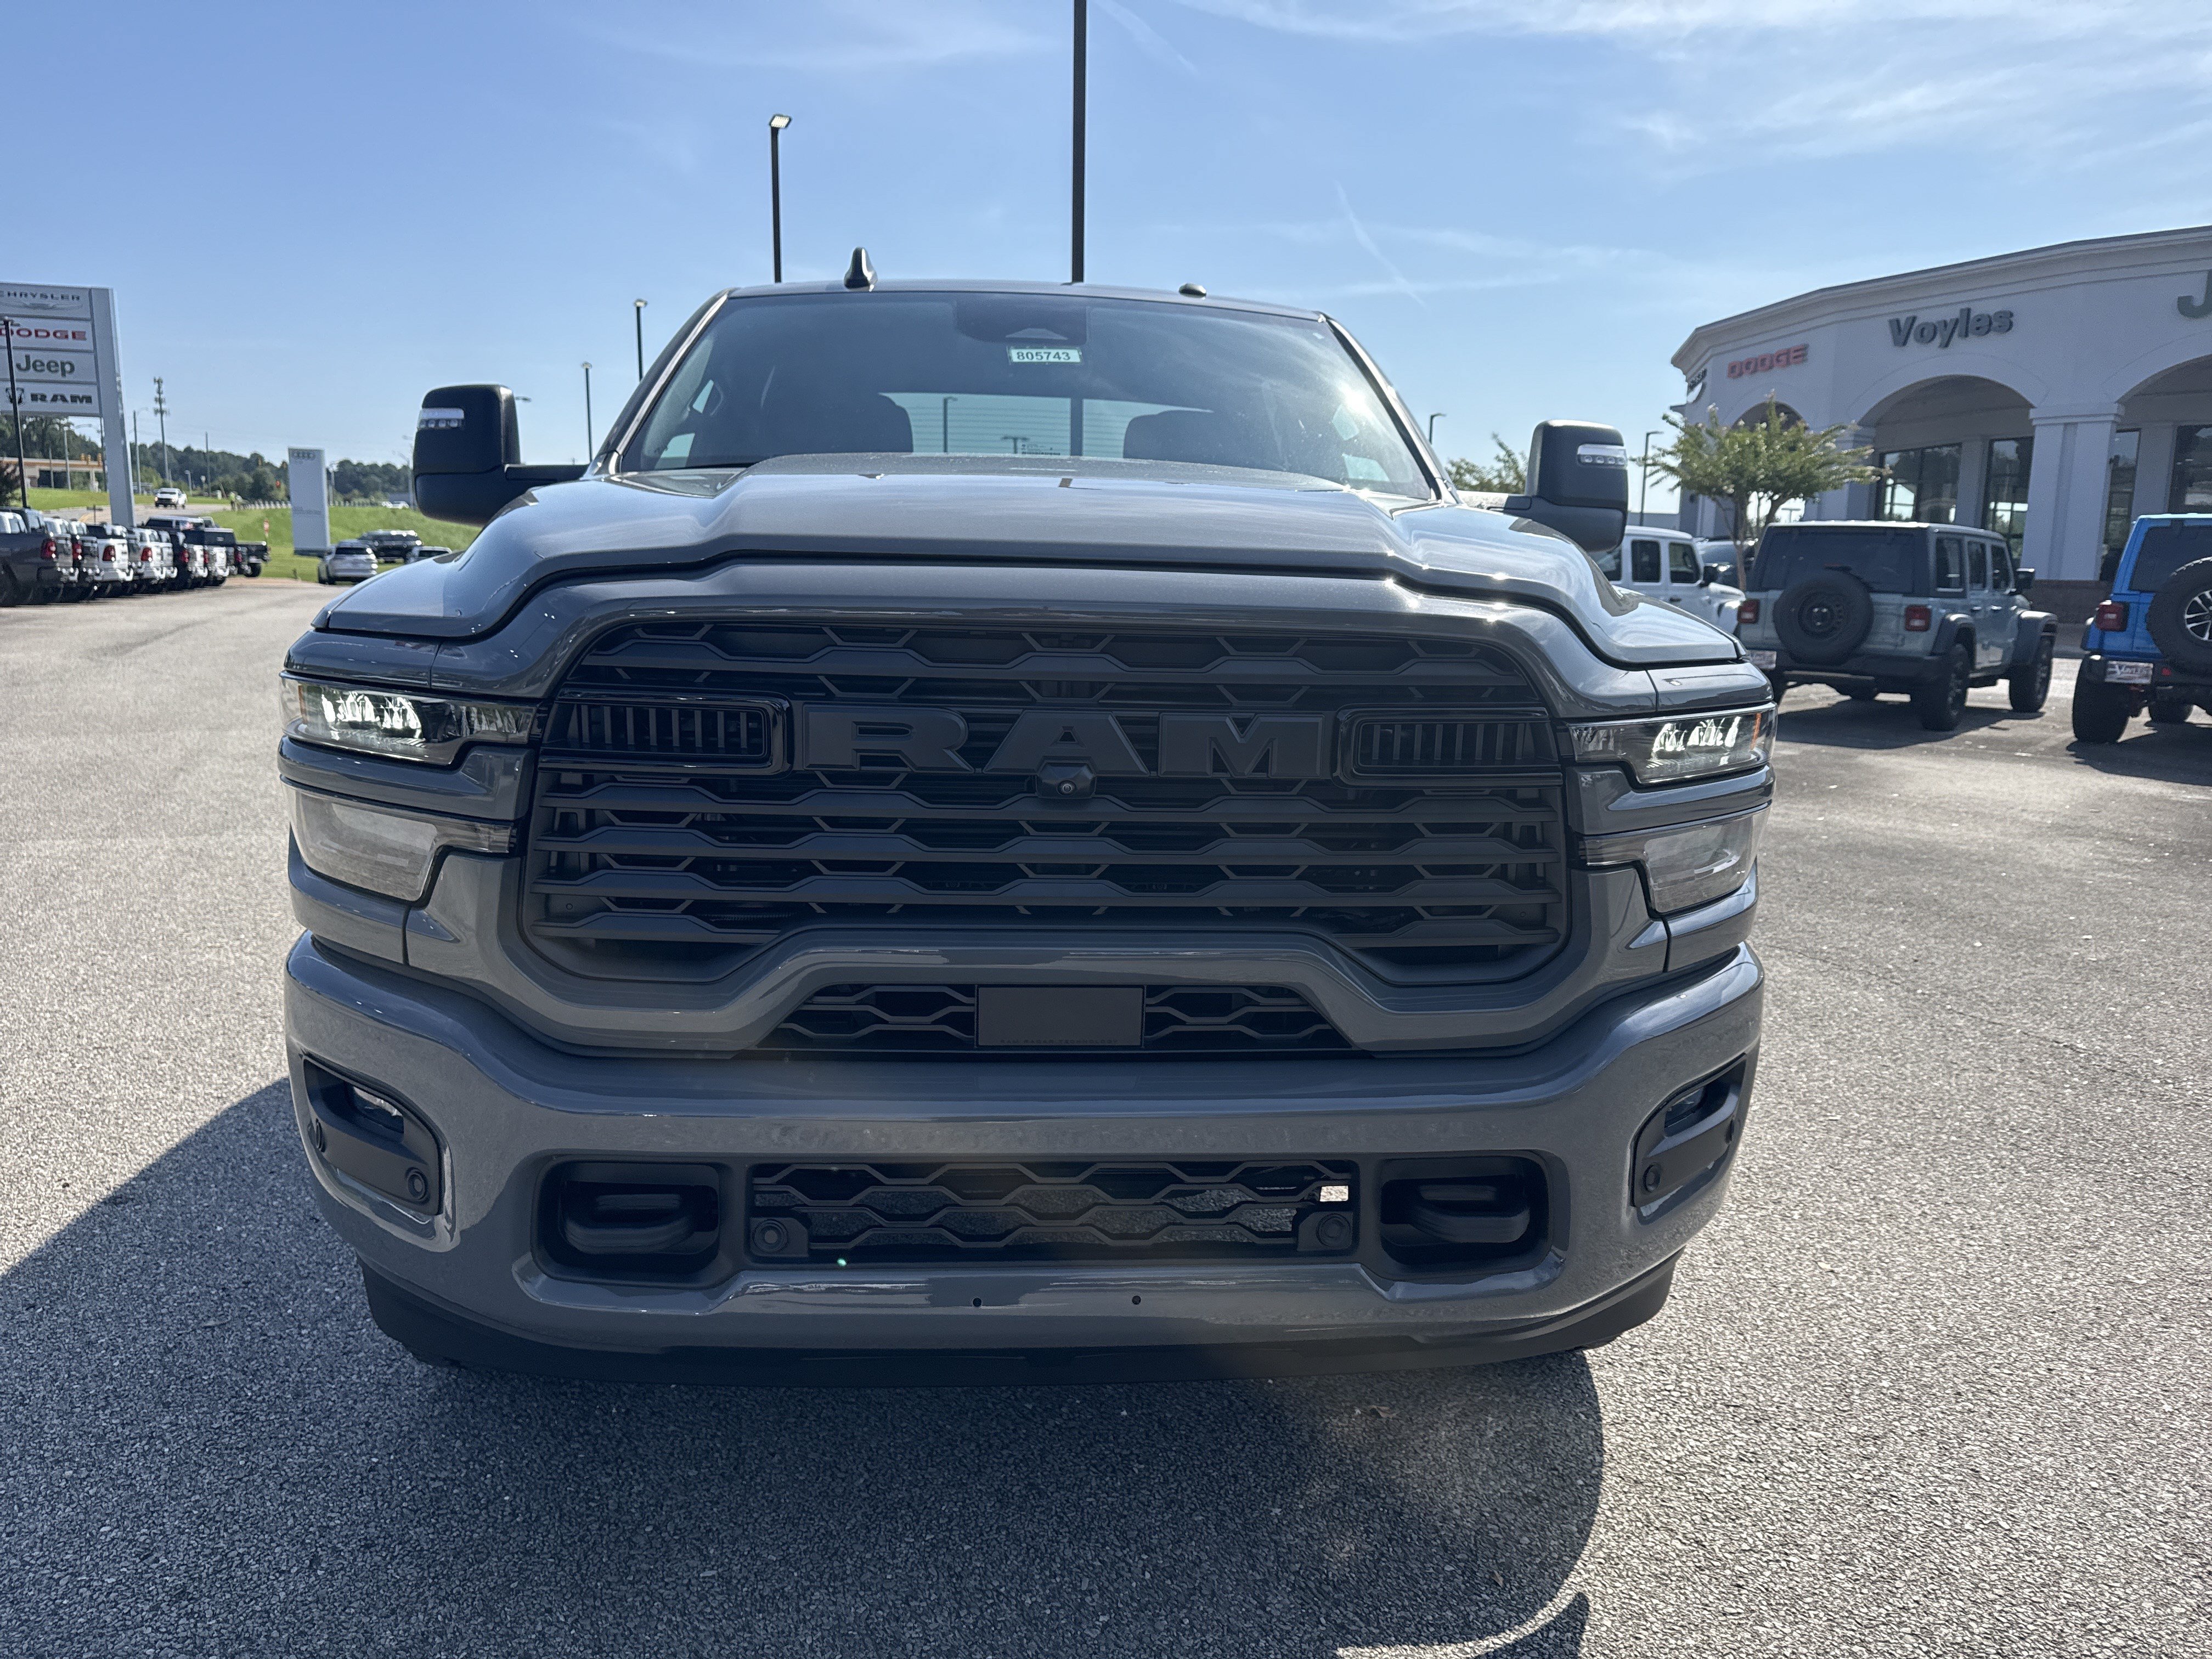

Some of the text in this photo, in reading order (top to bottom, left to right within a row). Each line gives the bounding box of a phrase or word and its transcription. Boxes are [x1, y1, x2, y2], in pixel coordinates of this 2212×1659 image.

[1888, 307, 2014, 348] Voyles
[15, 354, 75, 377] Jeep
[1017, 352, 1071, 360] 805743
[1727, 343, 1809, 379] DODGE
[30, 392, 92, 404] RAM
[802, 703, 1325, 777] RAM
